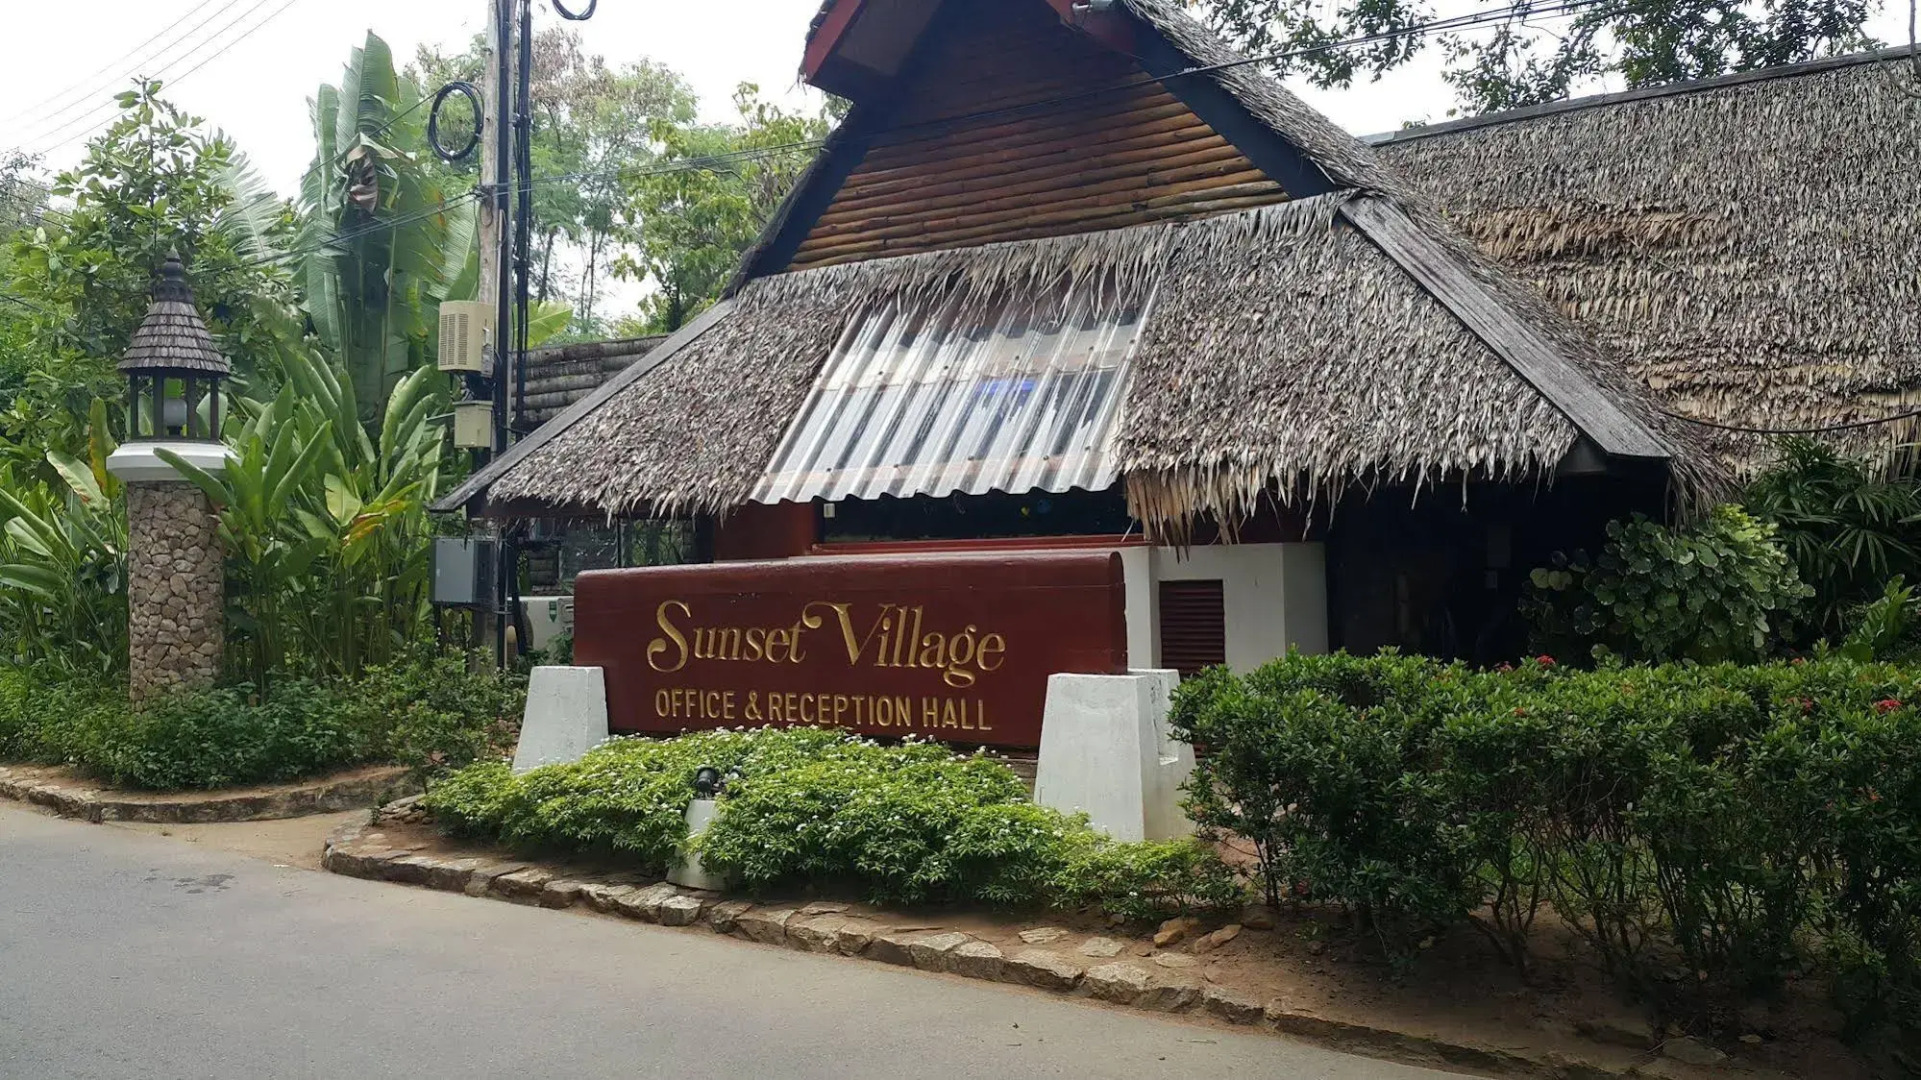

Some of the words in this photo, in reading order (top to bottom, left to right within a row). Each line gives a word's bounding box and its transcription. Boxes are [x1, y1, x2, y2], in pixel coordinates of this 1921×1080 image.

[647, 600, 808, 672] Sunset
[802, 602, 1006, 688] Village
[655, 688, 736, 720] OFFICE
[745, 690, 763, 721] &
[768, 693, 912, 728] RECEPTION
[922, 697, 993, 731] HALL
